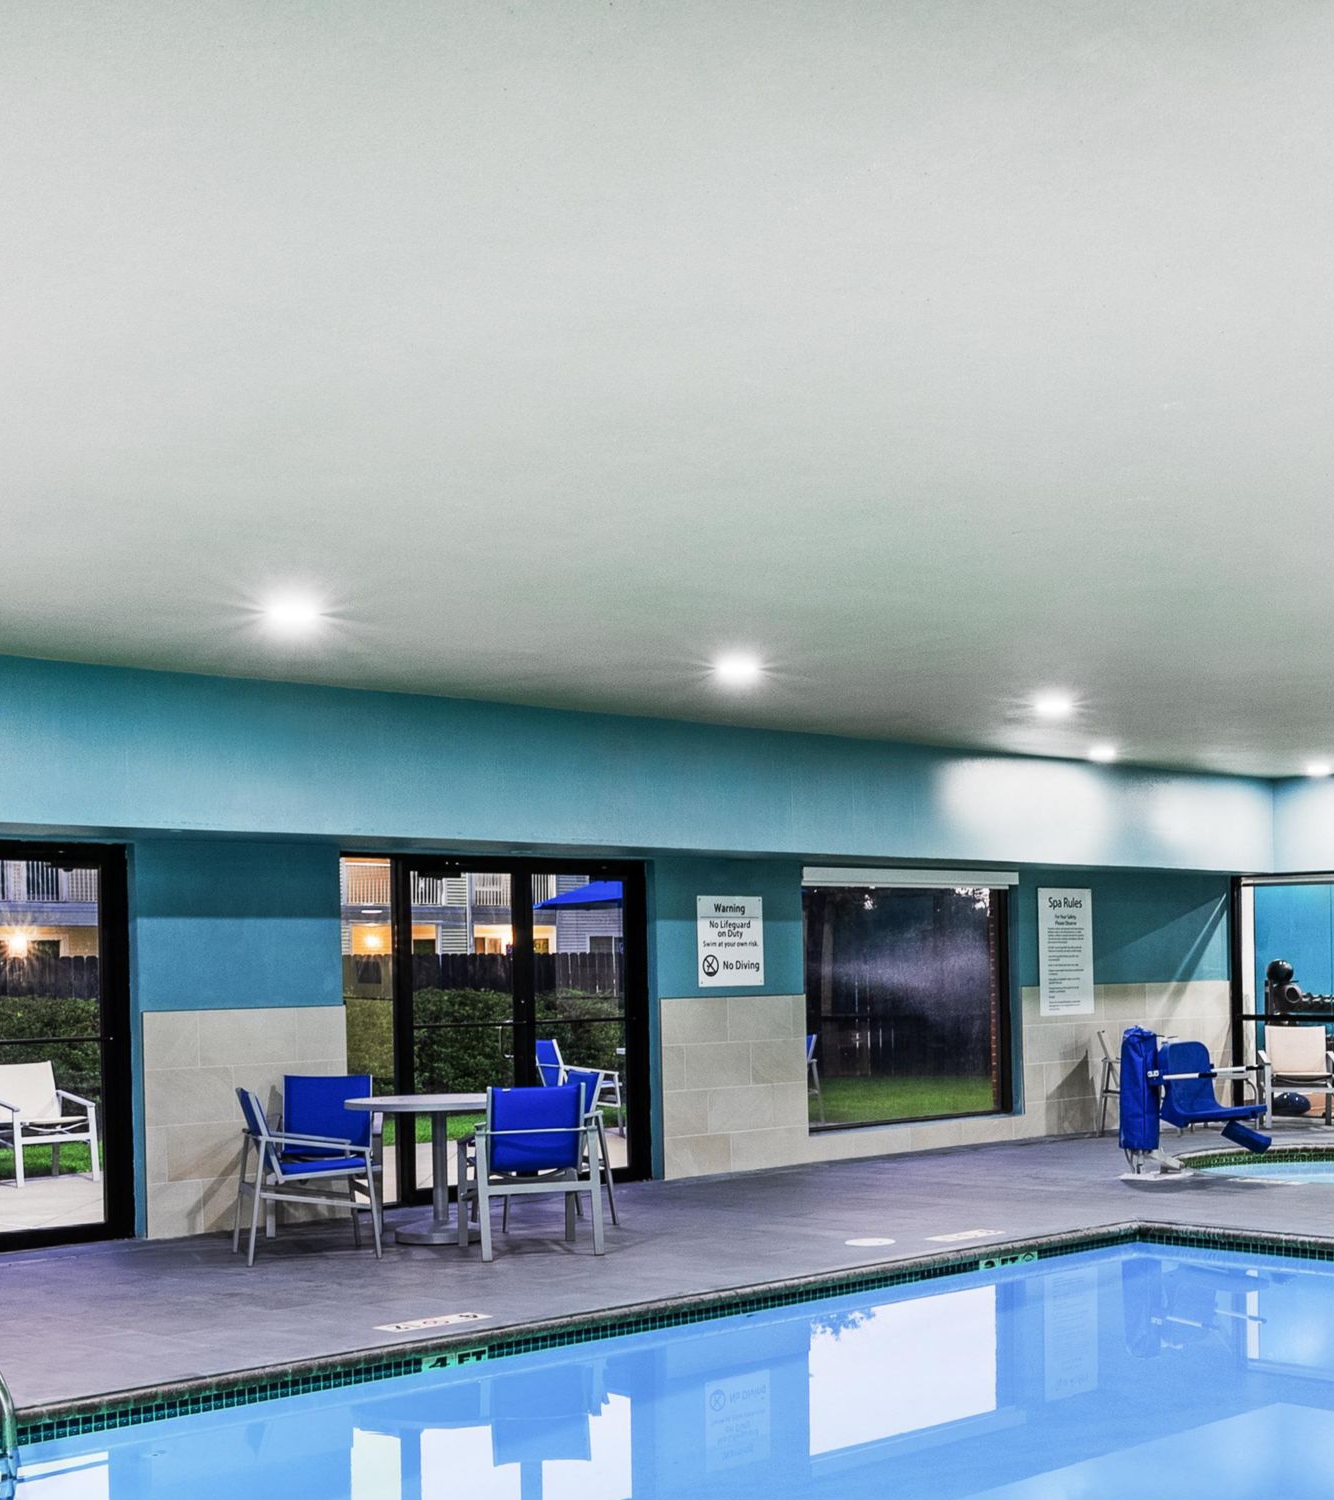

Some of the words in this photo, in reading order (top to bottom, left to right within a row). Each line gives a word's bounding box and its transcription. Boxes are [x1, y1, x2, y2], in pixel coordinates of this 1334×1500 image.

[1048, 896, 1062, 910] Spa
[1064, 897, 1082, 908] Rules
[714, 903, 746, 916] Warning
[709, 920, 718, 928] No
[720, 920, 750, 930] Lifeguard
[728, 930, 743, 939] Duty
[723, 961, 734, 970] No
[736, 960, 759, 972] Diving
[429, 1356, 450, 1368] 4
[458, 1350, 486, 1364] FT
